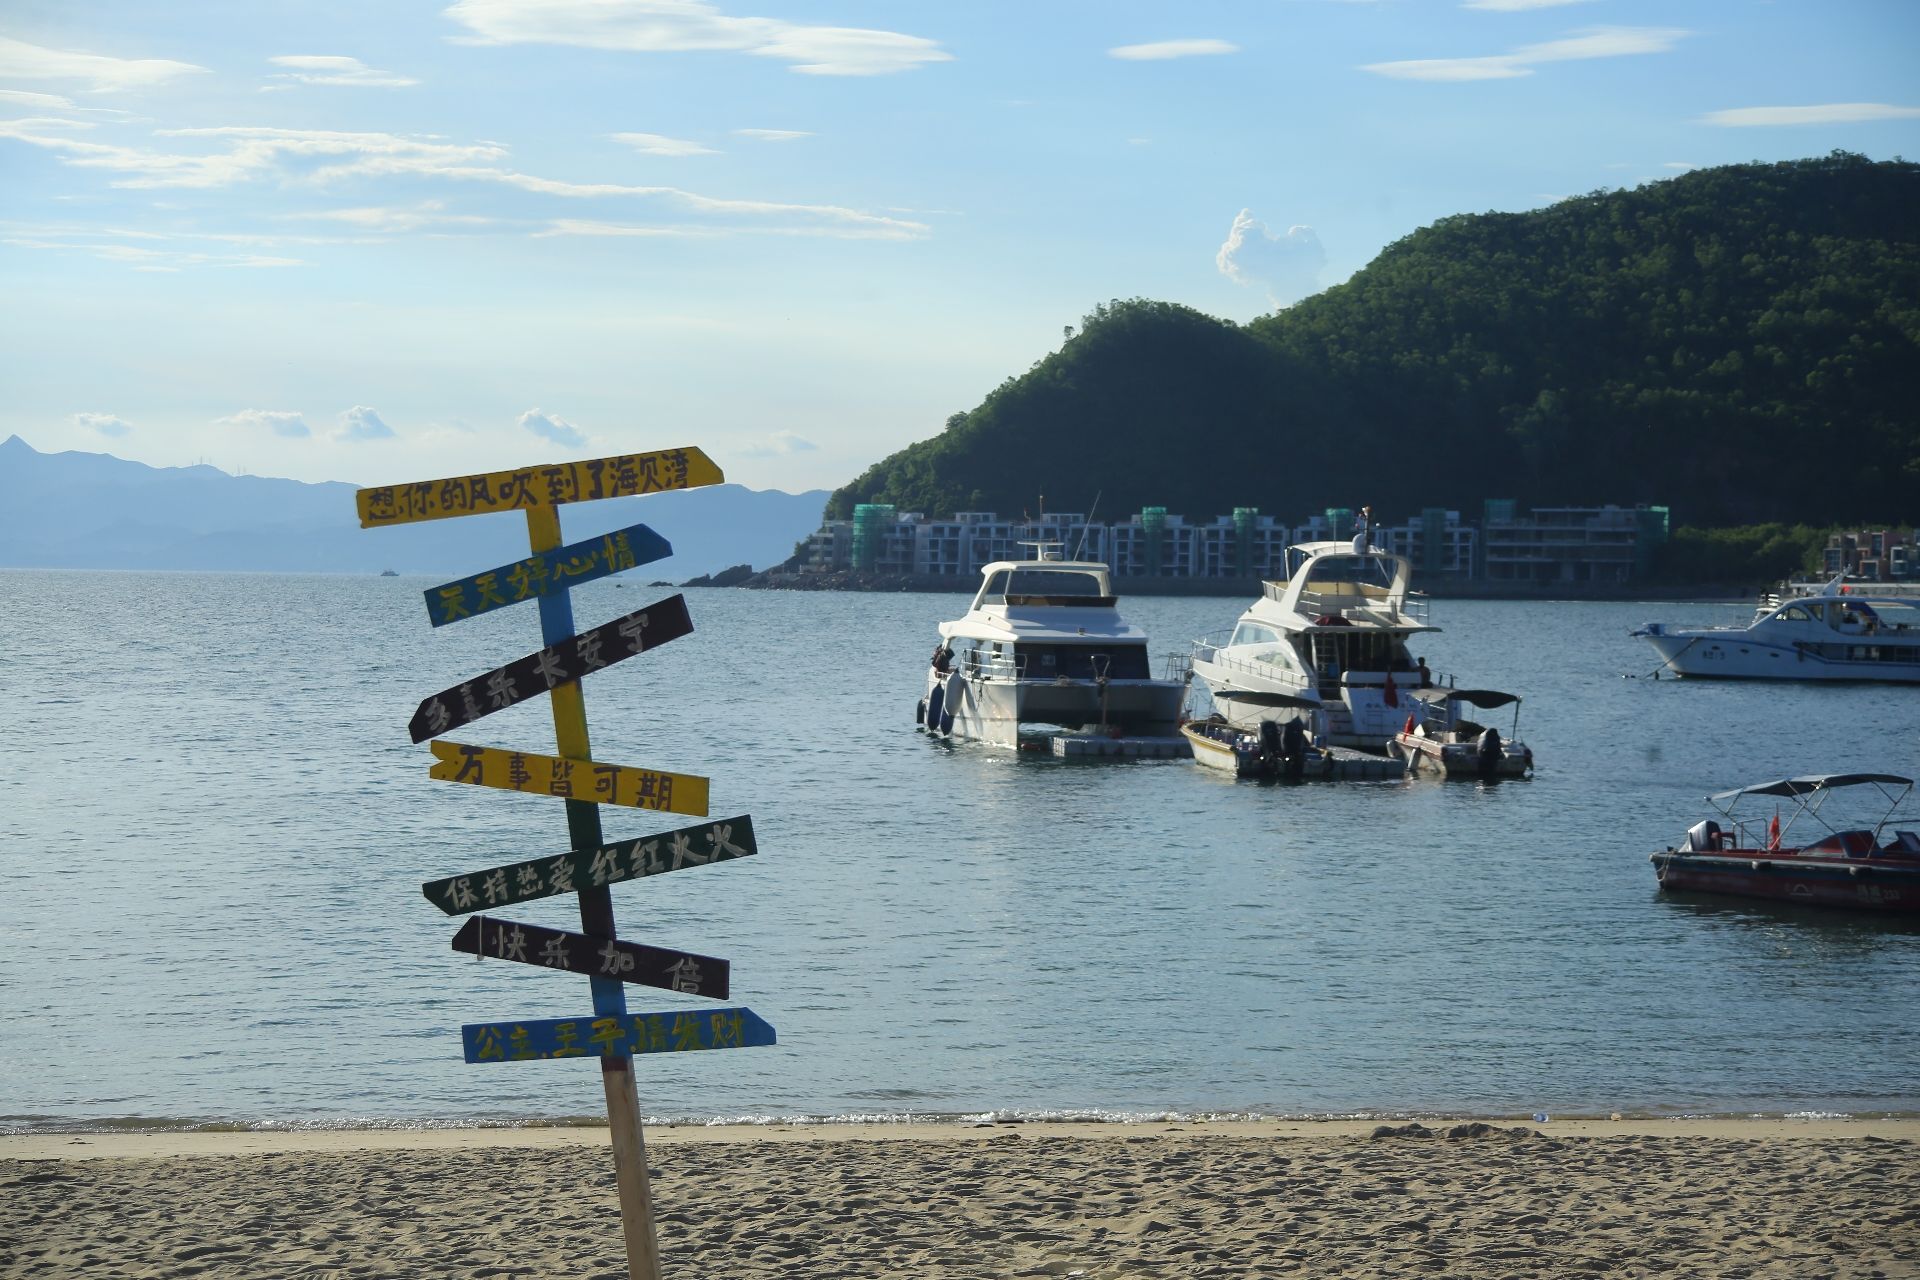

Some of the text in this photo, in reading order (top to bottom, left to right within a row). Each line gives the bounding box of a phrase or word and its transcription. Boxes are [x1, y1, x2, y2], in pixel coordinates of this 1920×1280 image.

[368, 448, 689, 520] 想你的风吹到了海贝湾
[439, 531, 636, 621] 天天好心情
[454, 746, 672, 811] 万事皆可期
[445, 824, 747, 910] 保持热爱红红火火
[493, 924, 703, 993] 快乐加倍
